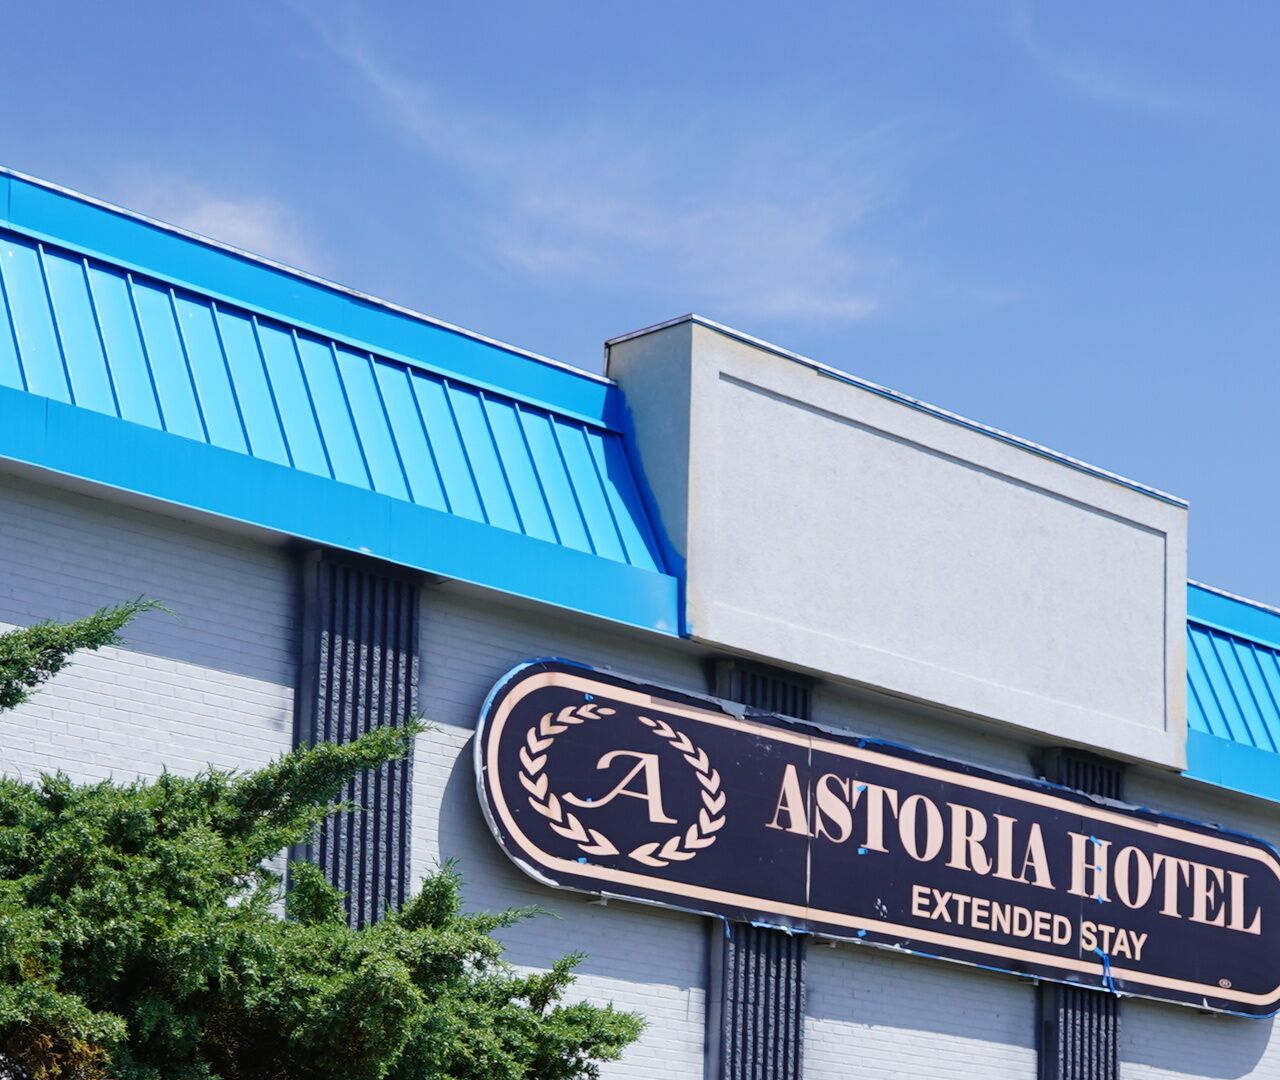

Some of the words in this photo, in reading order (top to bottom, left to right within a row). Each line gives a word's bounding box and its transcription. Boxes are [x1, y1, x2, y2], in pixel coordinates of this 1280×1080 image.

[561, 750, 678, 824] A
[765, 764, 1056, 890] ASTORIA
[1067, 831, 1262, 935] HOTEL
[911, 884, 1072, 946] EXTENDED
[1082, 921, 1148, 961] STAY
